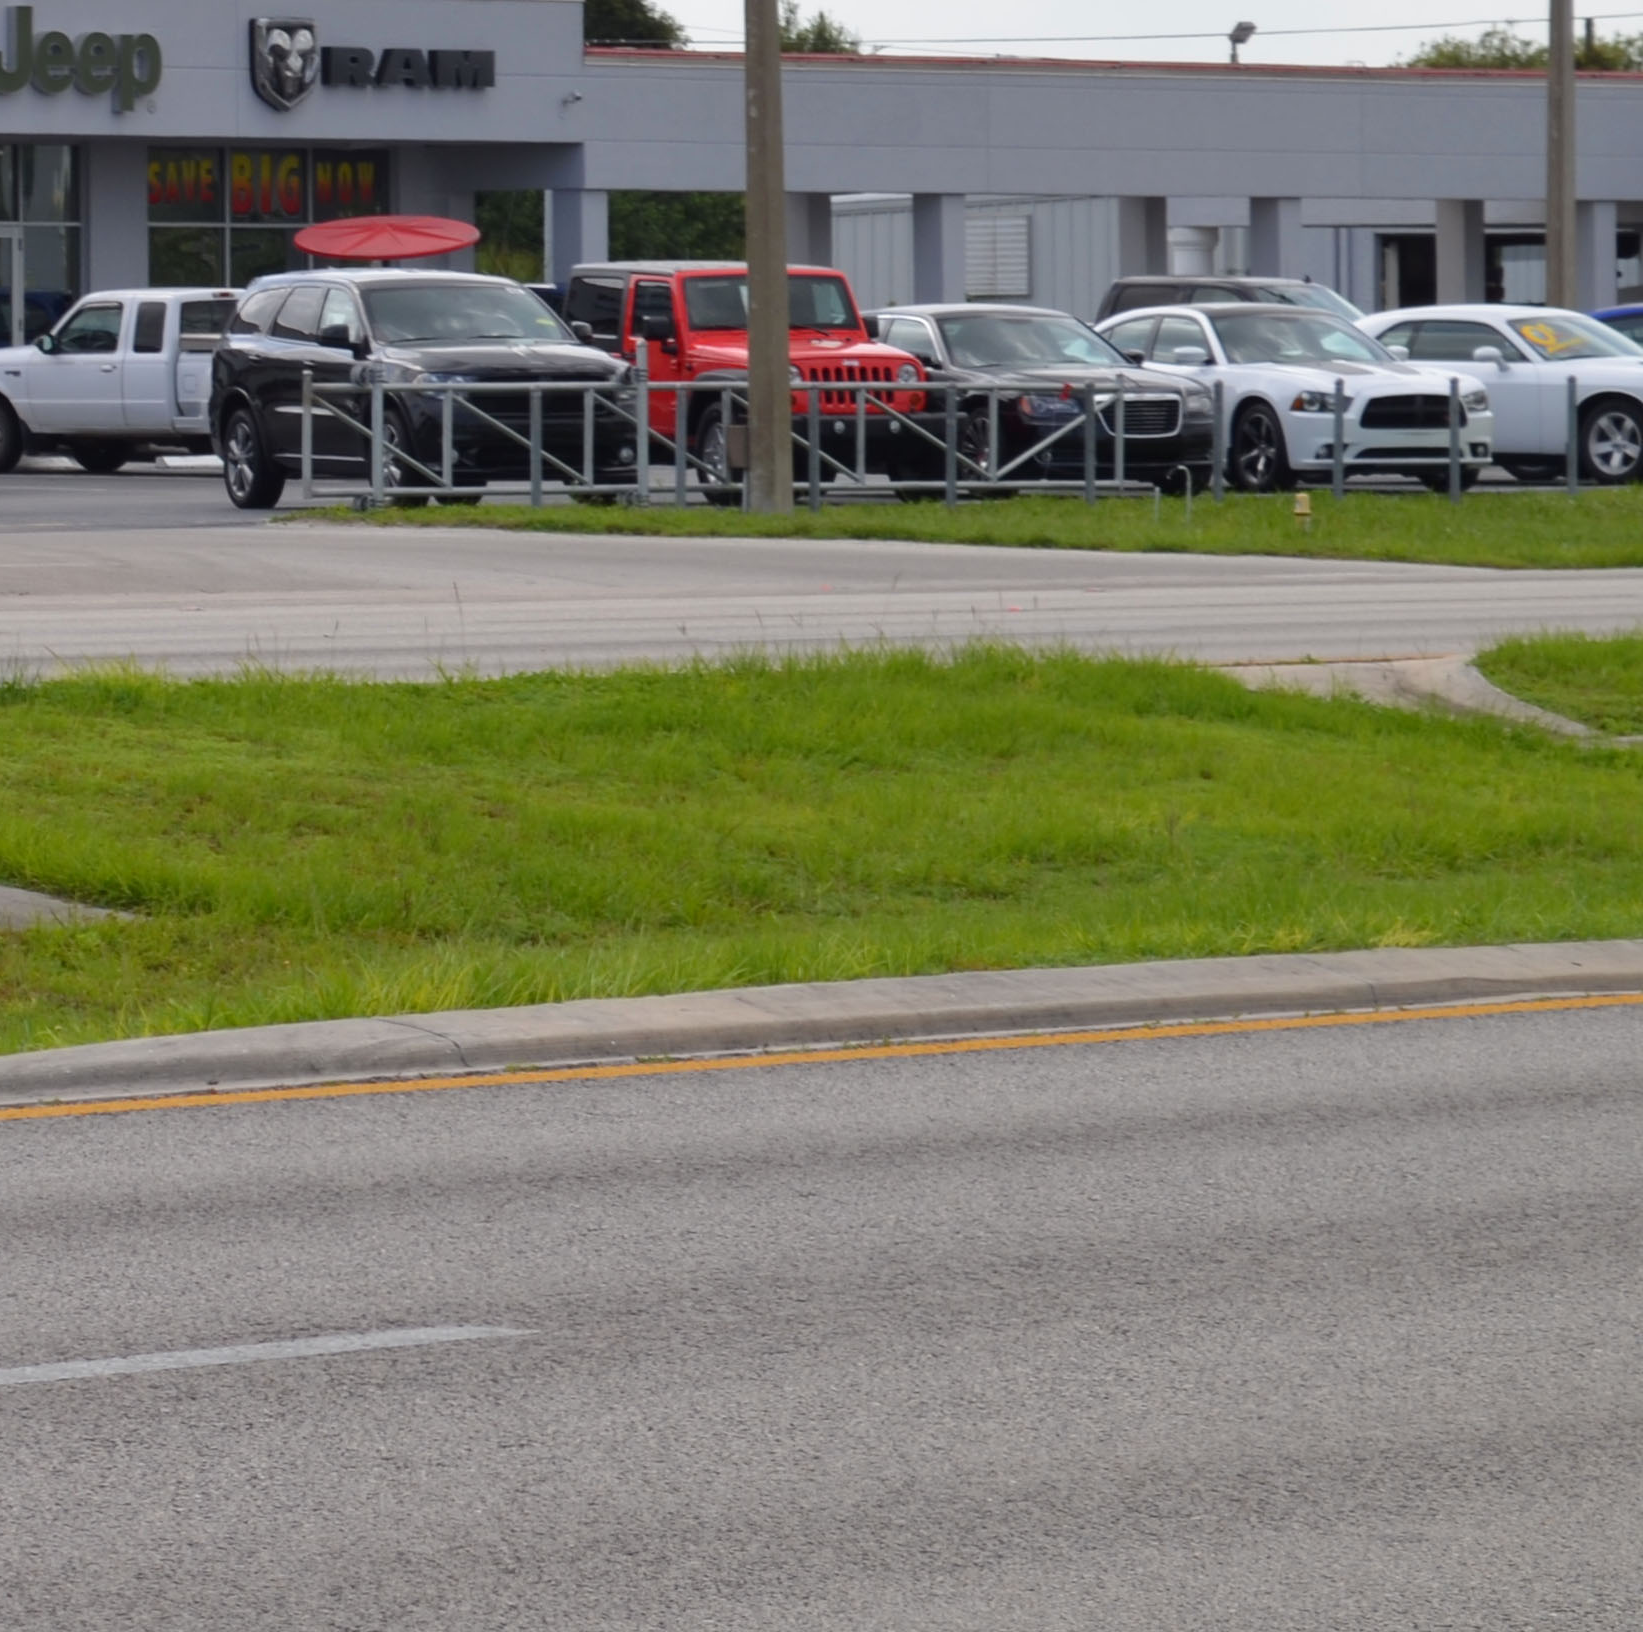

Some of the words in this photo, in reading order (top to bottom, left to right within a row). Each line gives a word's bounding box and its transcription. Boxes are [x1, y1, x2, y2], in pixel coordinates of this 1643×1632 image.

[320, 46, 496, 89] RAM
[147, 160, 214, 205] SAVE
[231, 152, 301, 216] BIG
[316, 161, 376, 204] NOW
